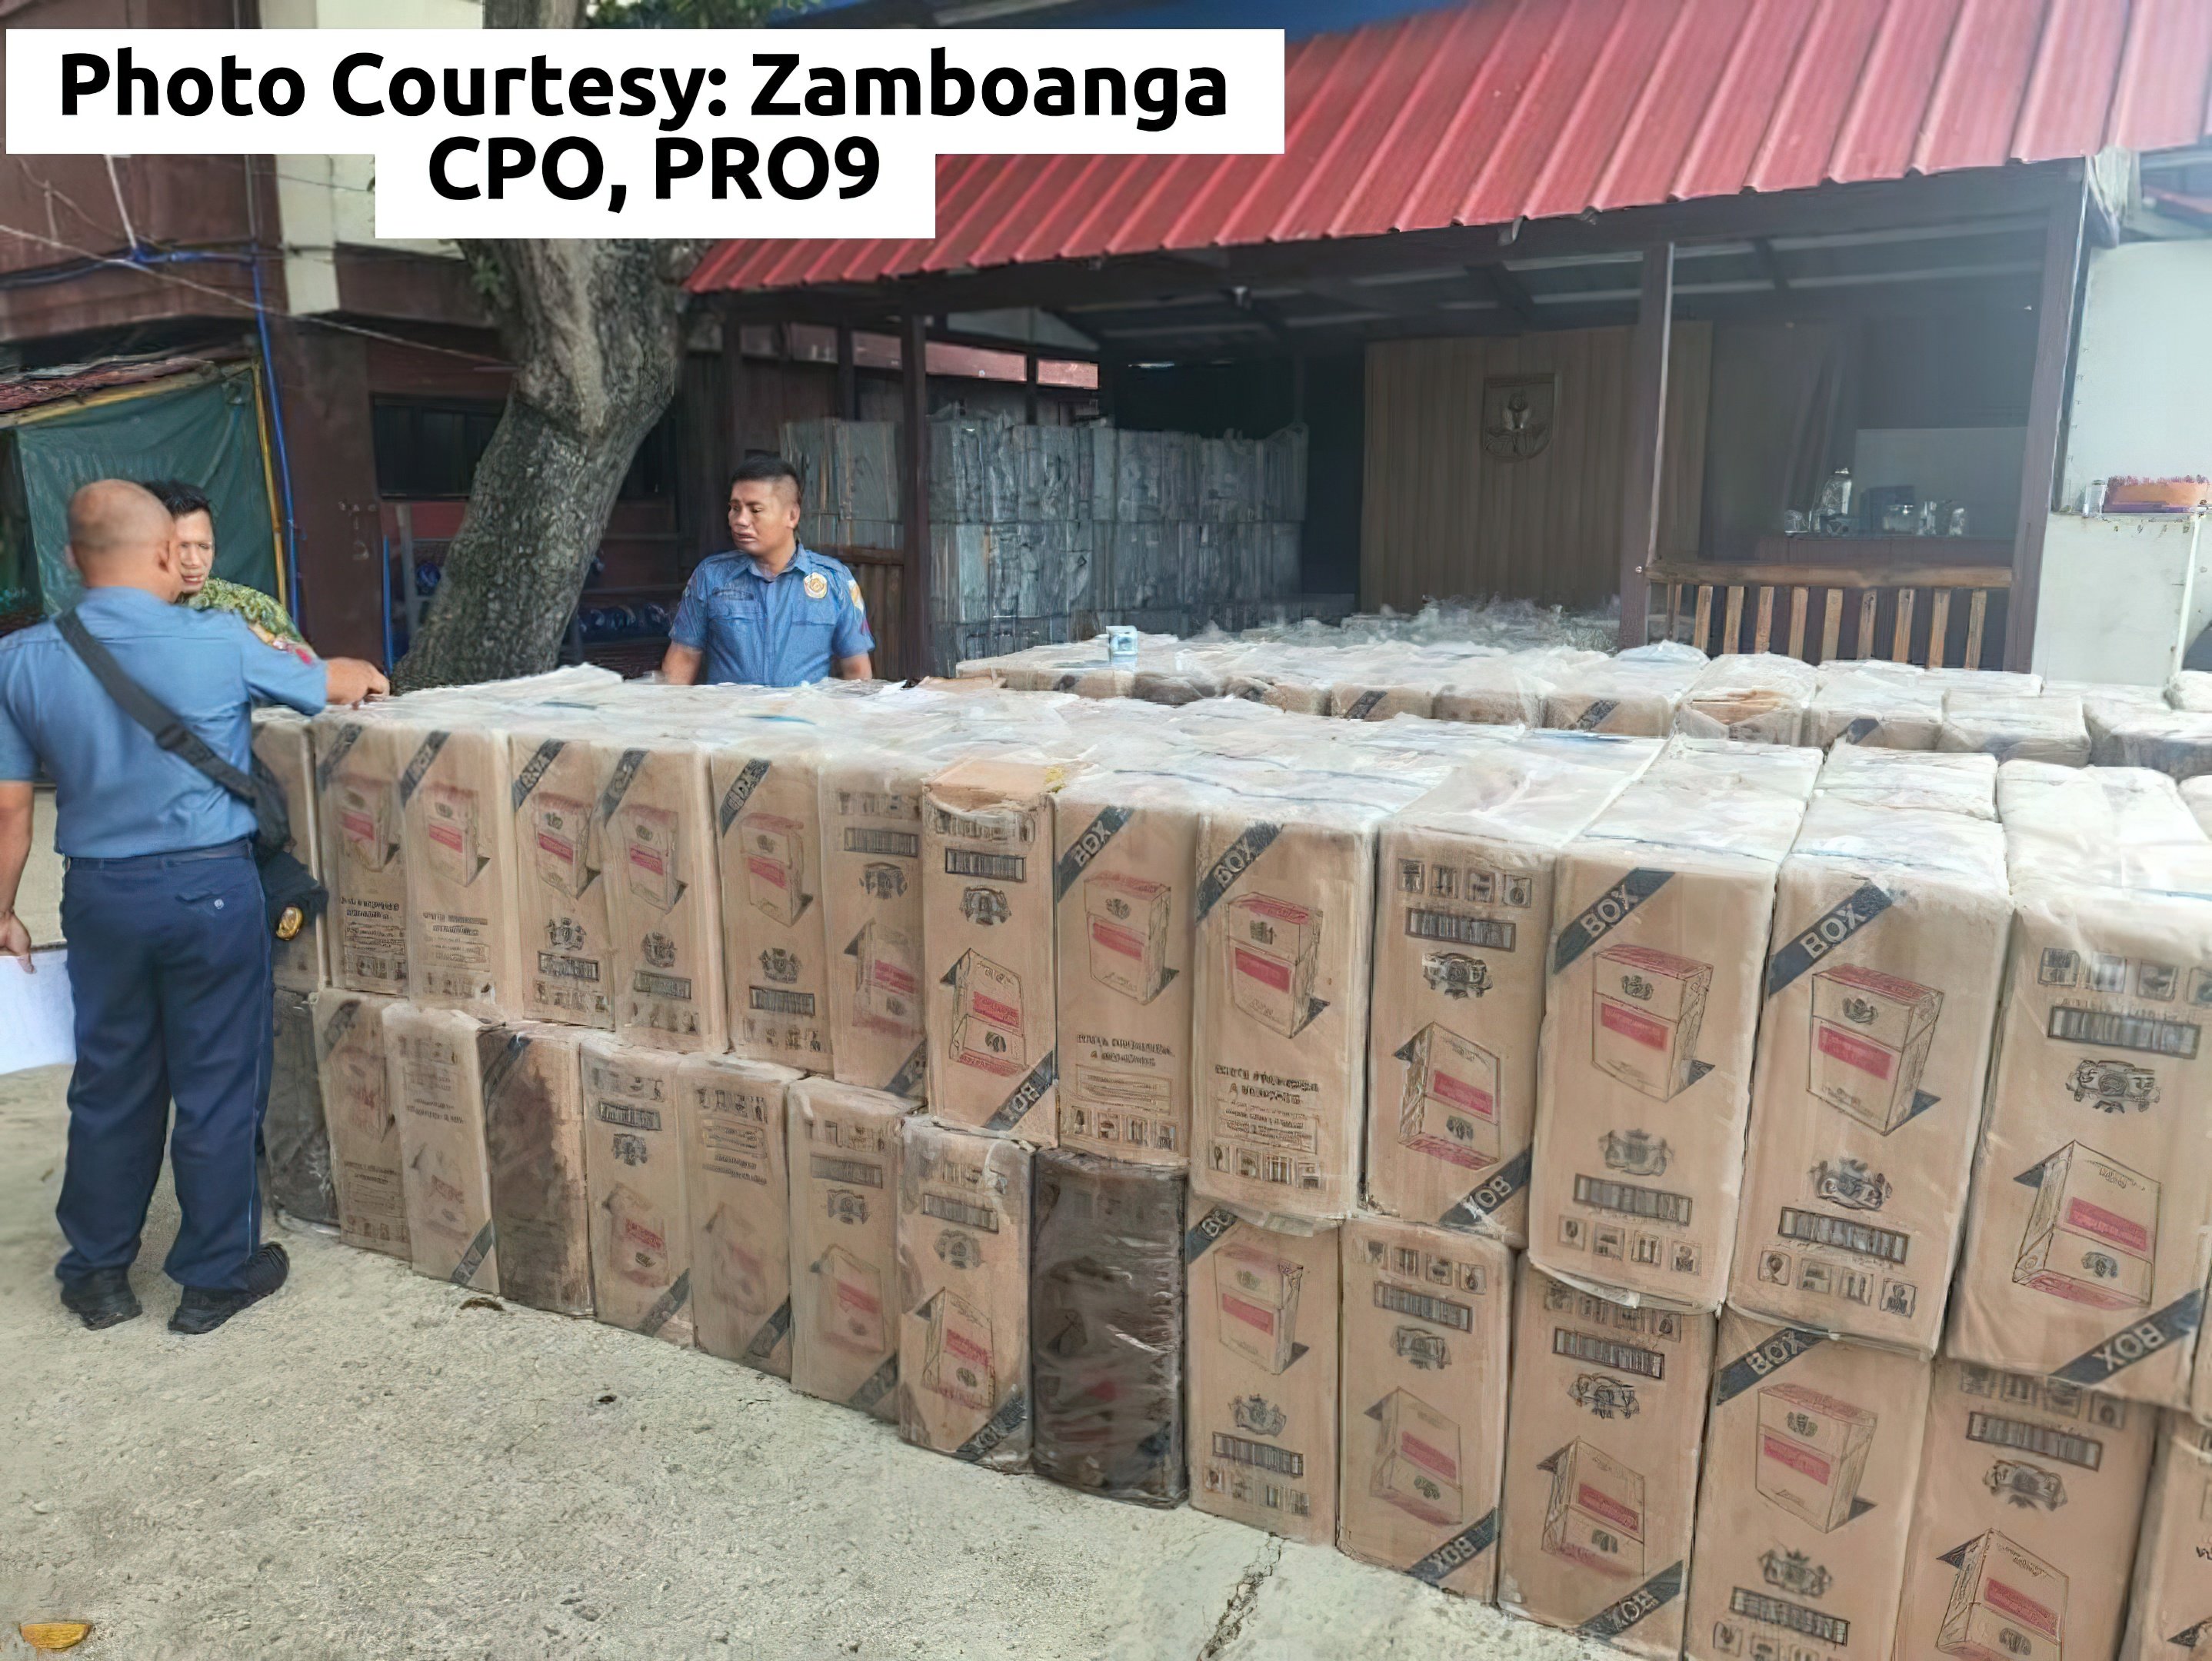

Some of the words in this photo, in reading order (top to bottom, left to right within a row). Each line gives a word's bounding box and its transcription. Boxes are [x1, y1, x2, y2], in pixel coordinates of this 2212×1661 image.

[1074, 821, 1113, 867] BOX
[1581, 884, 1638, 937] BOX
[1801, 904, 1867, 958] BOX
[1747, 1332, 1809, 1376] BOX
[2092, 1323, 2166, 1370] BOX
[1426, 1536, 1477, 1573] BOX
